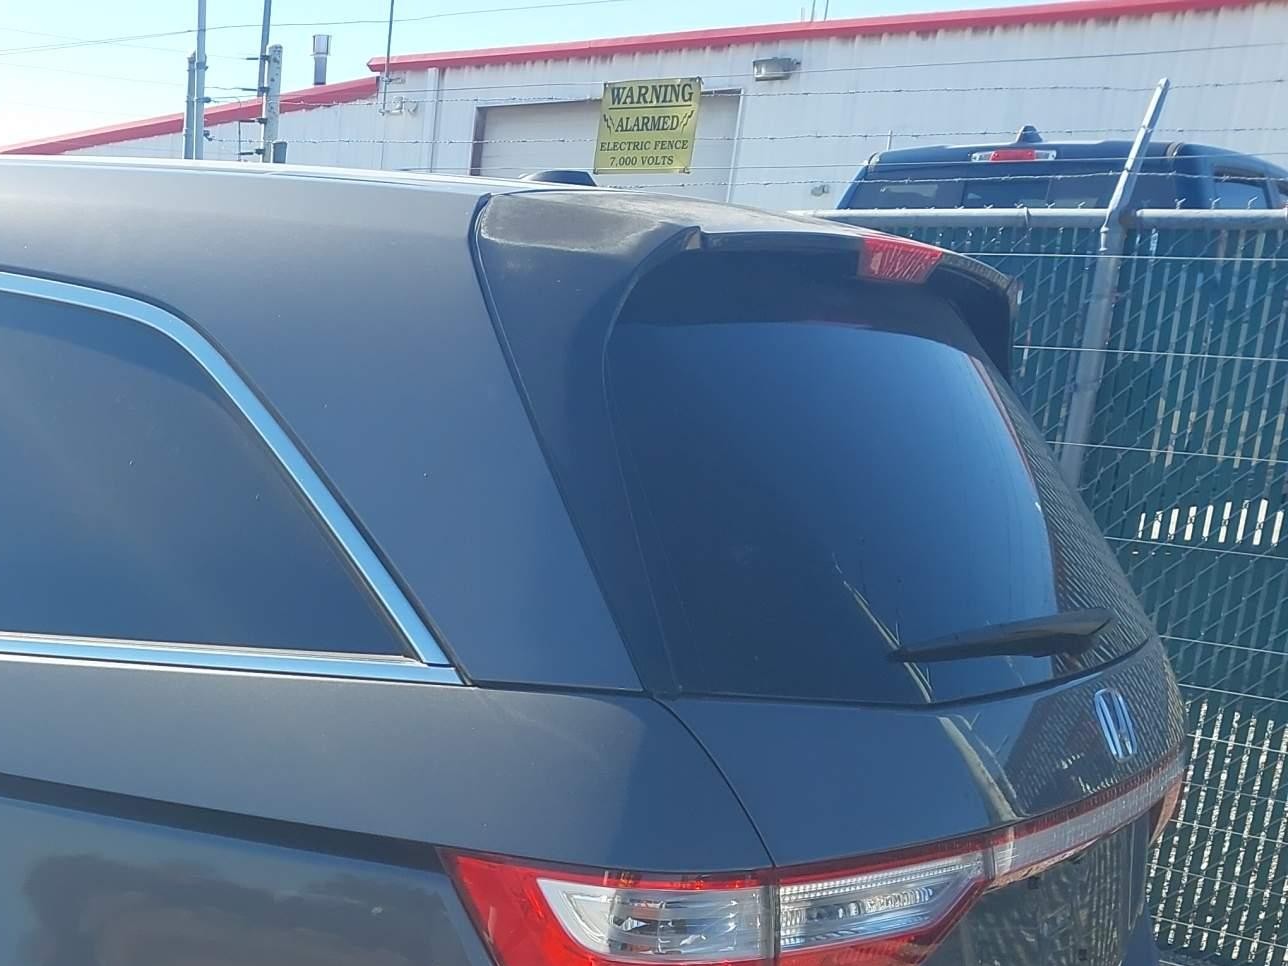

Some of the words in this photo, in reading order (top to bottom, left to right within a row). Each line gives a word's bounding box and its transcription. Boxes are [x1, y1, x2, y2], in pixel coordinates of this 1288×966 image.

[610, 83, 694, 105] WARNING
[615, 115, 680, 132] ALARMED
[599, 141, 651, 152] ELECTRIC
[653, 140, 689, 150] FENCE
[610, 156, 638, 167] 7,000
[641, 155, 674, 166] VOLTS
